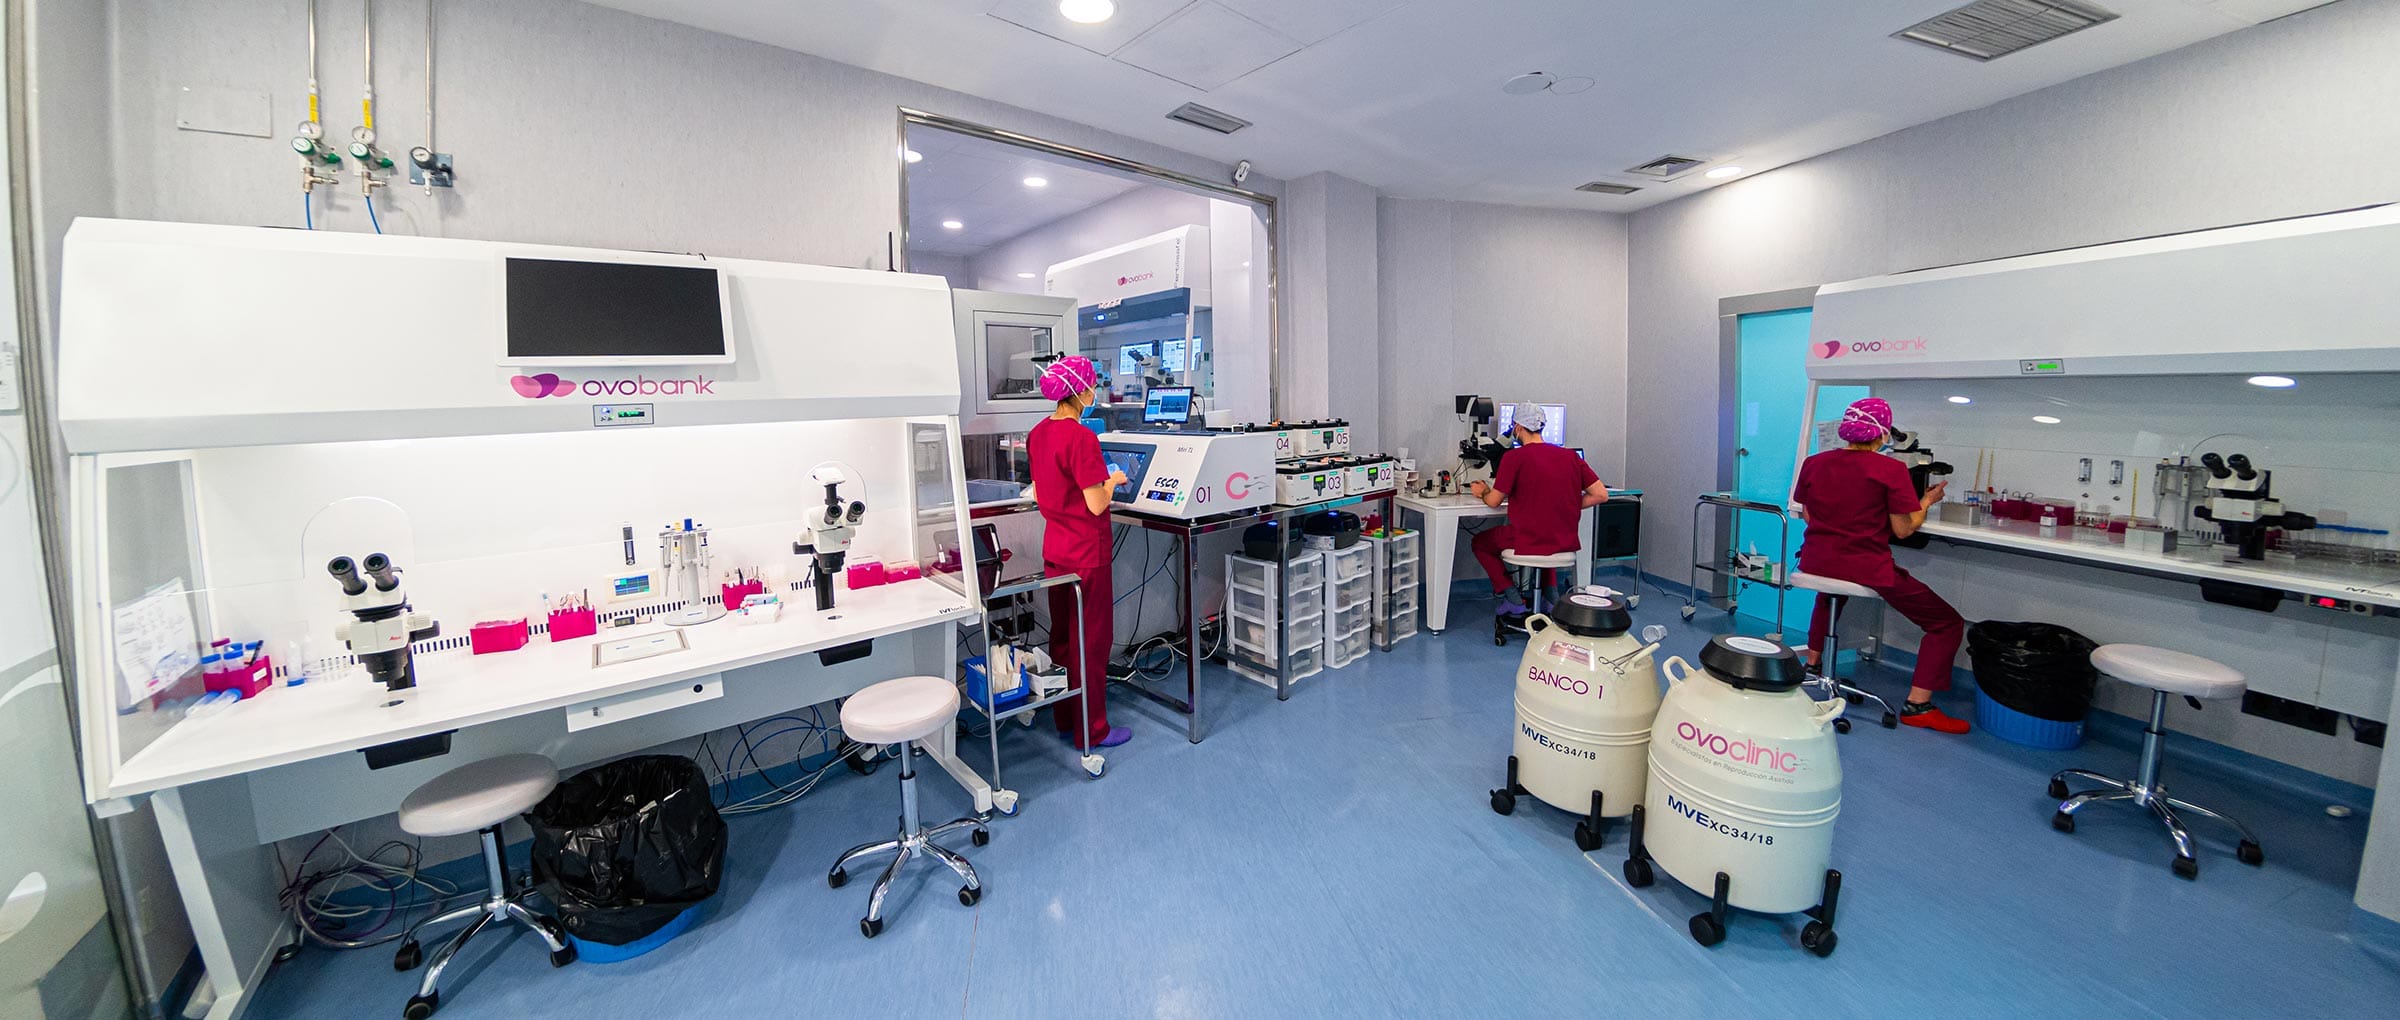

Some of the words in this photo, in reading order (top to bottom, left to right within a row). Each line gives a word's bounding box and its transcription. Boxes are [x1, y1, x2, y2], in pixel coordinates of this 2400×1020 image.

[1128, 271, 1154, 284] ovobank
[1852, 335, 1928, 353] ovobank
[582, 374, 715, 396] ovobank
[1276, 438, 1289, 450] 04
[1336, 433, 1348, 445] 05
[1380, 468, 1391, 481] 02
[1154, 477, 1179, 489] ESCO
[1328, 476, 1341, 490] 03
[1196, 486, 1211, 504] 01
[1528, 666, 1589, 695] BANCO
[1598, 685, 1604, 700] 1
[1670, 738, 1712, 764] Especialistas
[1677, 722, 1797, 773] ovoclinic
